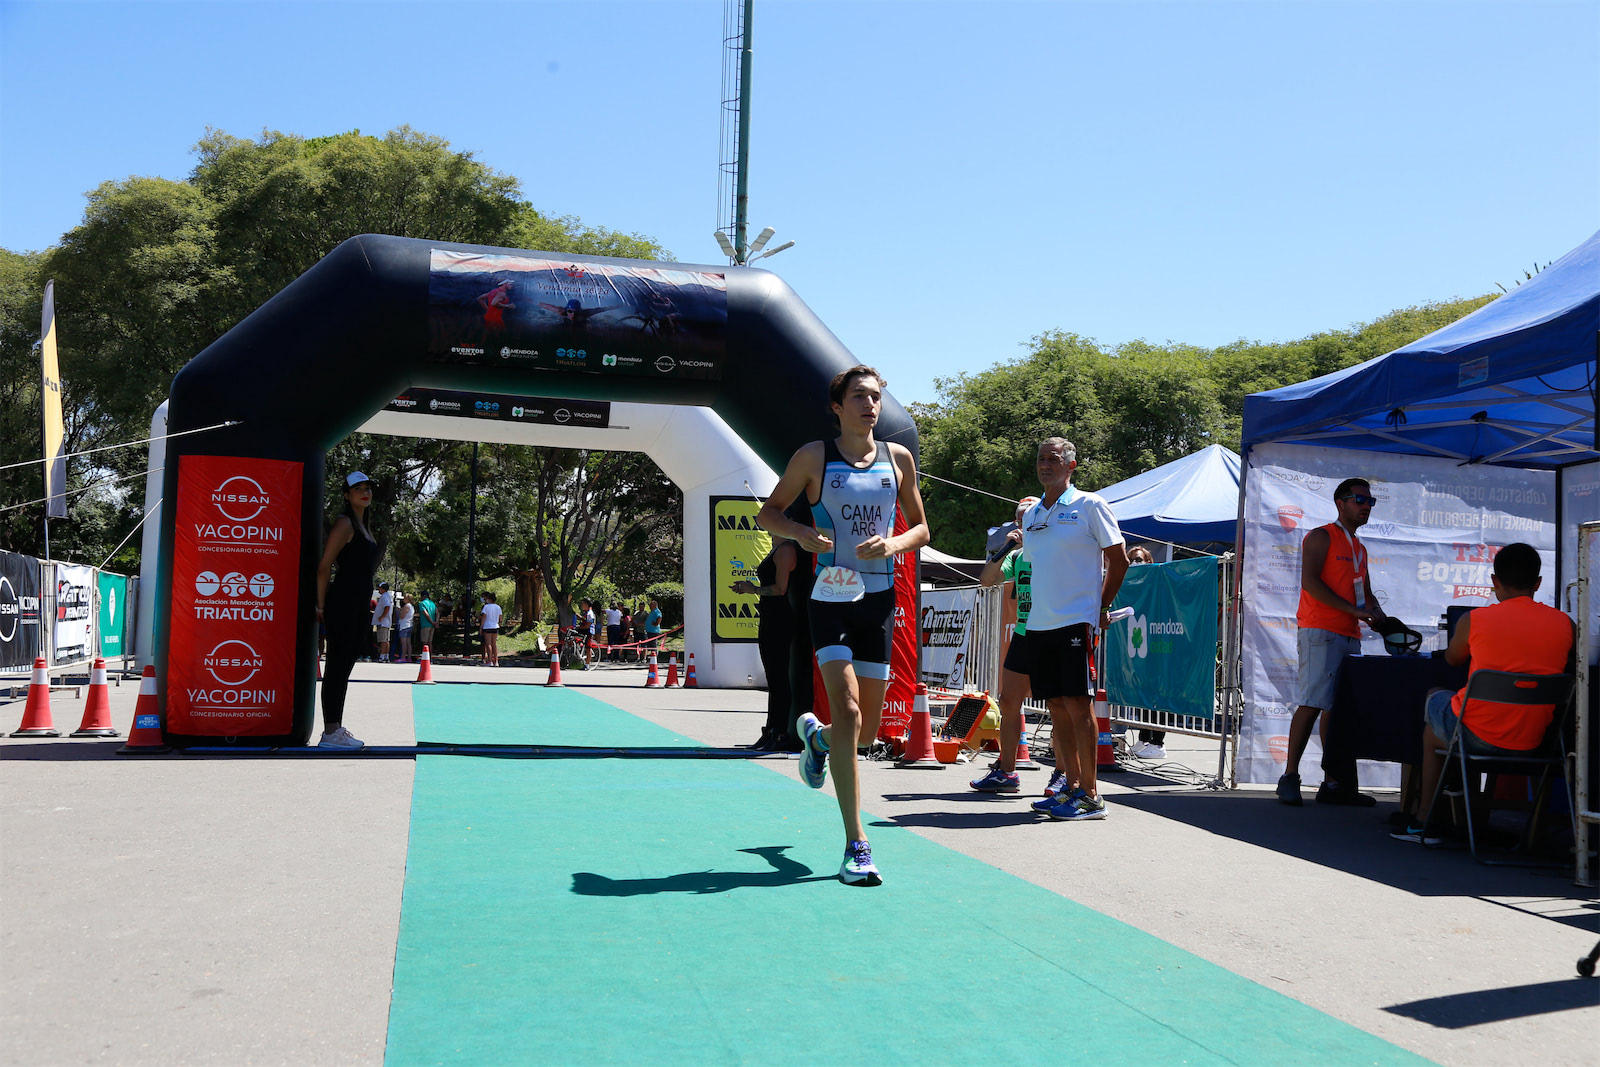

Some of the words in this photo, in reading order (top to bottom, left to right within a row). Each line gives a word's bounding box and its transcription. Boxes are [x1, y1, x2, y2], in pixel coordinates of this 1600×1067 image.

[679, 360, 714, 368] YACOPINI
[573, 412, 602, 420] YACOPINI
[211, 493, 270, 505] NISSAN
[841, 504, 882, 521] CAMA
[194, 523, 283, 541] YACOPINI
[851, 521, 876, 537] ARG
[197, 546, 252, 554] CONCESIONARIO
[822, 566, 858, 587] 242
[230, 599, 264, 607] Mendocina
[193, 605, 274, 621] TRIATLÓN
[1150, 618, 1184, 635] mendoza
[204, 658, 263, 667] NISSAN
[186, 688, 276, 703] YACOPINI
